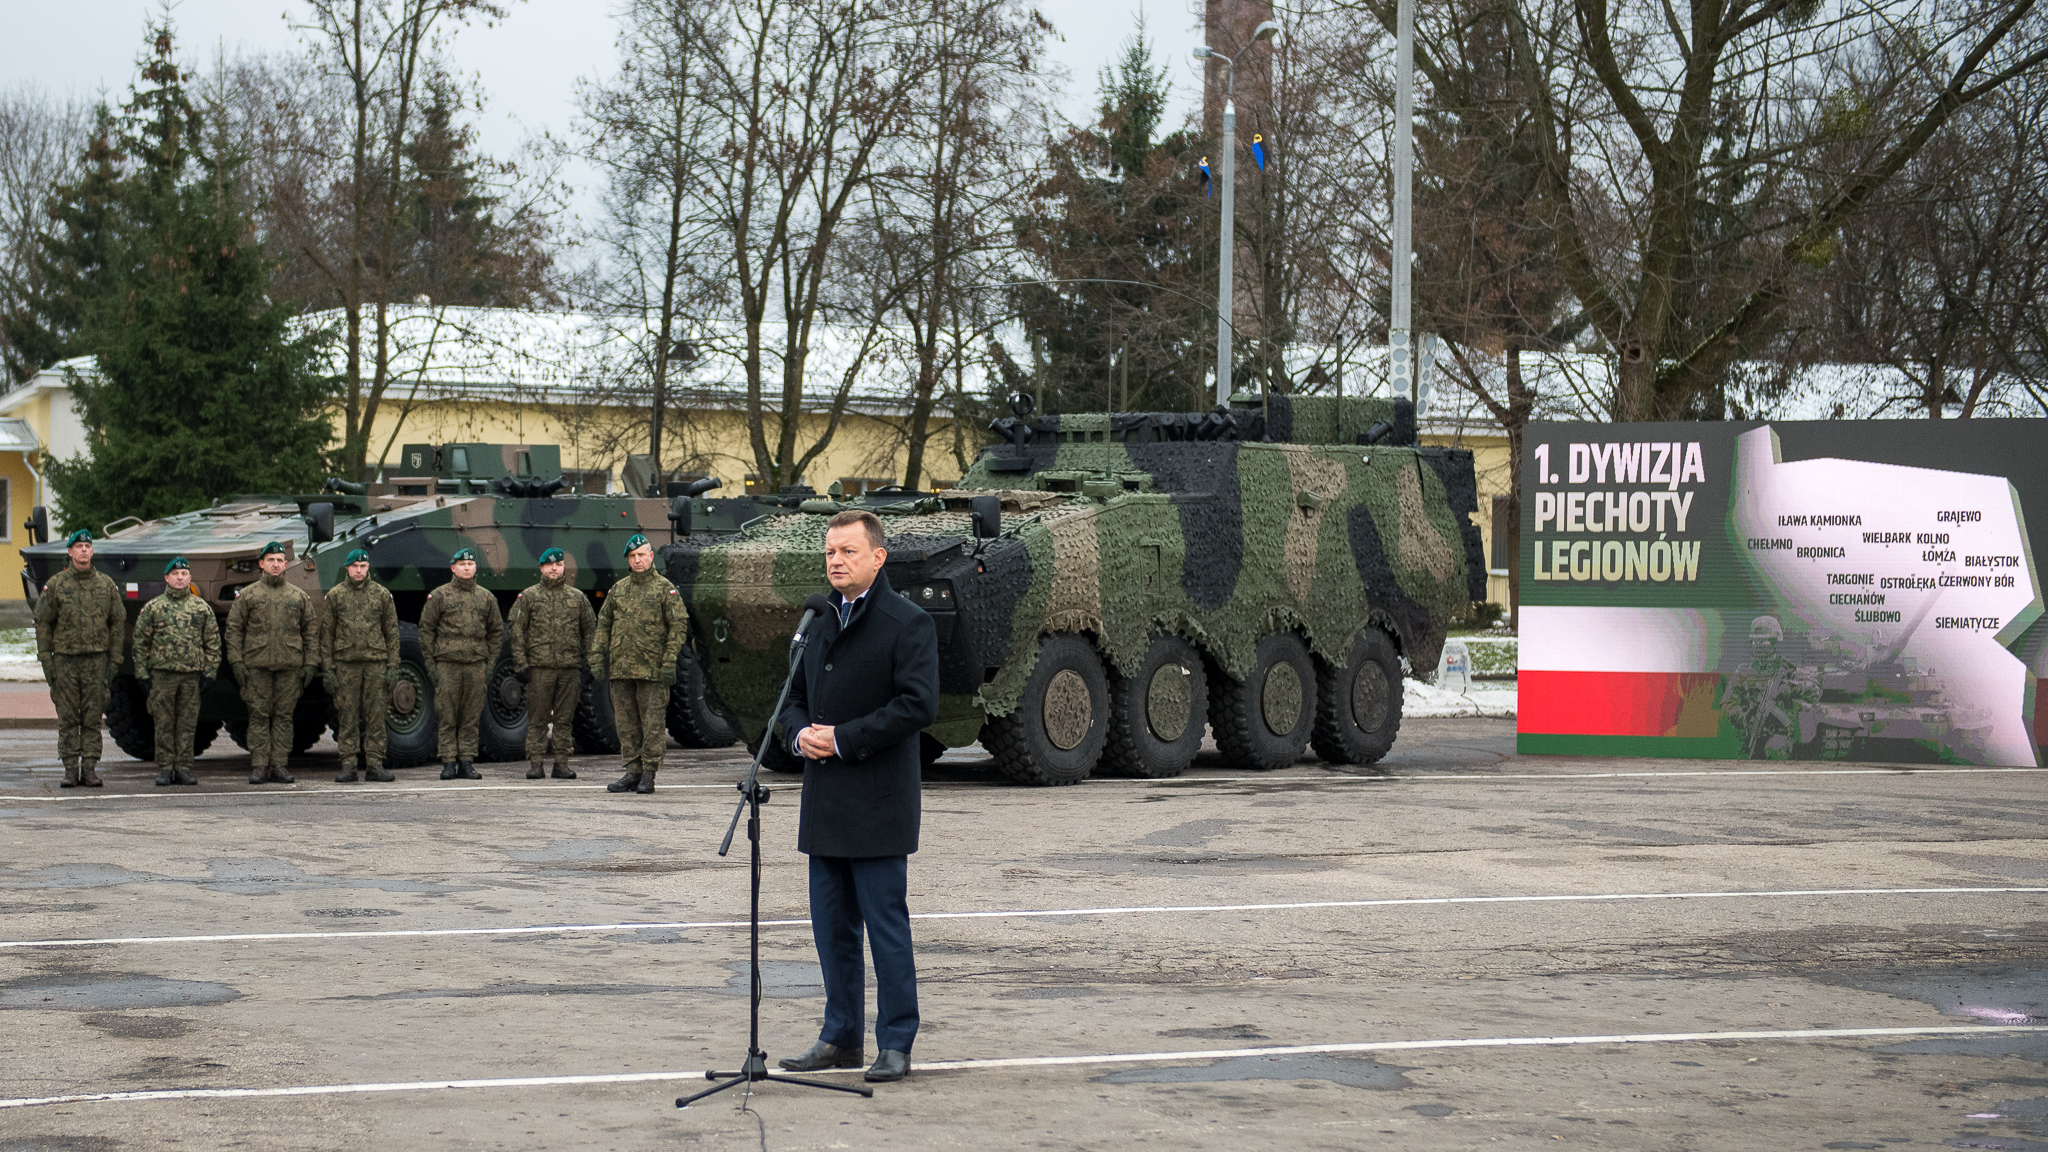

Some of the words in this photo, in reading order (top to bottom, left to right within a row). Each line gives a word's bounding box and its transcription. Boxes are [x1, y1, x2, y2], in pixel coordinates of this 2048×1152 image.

[1534, 443, 1560, 484] 1.
[1568, 442, 1706, 491] DYWIZJA
[1534, 491, 1694, 532] PIECHOTY
[1937, 510, 1982, 524] GRAJEWO
[1778, 515, 1808, 527] IŁAWA
[1810, 515, 1862, 527] KAMIONKA
[1747, 538, 1793, 550] CHEŁMNO
[1862, 532, 1912, 544] WIELBARK
[1916, 533, 1950, 545] KOLNO
[1533, 532, 1701, 582] LEGIONÓW
[1796, 547, 1846, 559] BRODNICA
[1922, 548, 1957, 562] ŁOMŻA
[1964, 556, 2020, 568] BIAŁYSTOK
[1826, 573, 1875, 586] TARGONIE
[1880, 577, 1937, 592] OSTROŁĘKA
[1938, 575, 1992, 588] CZERWONY
[1994, 573, 2015, 588] BÓR
[1829, 591, 1886, 606] CIECHANÓW
[1854, 608, 1901, 623] ŚLUBOWO
[1935, 616, 2000, 630] SIEMIATYCZE
